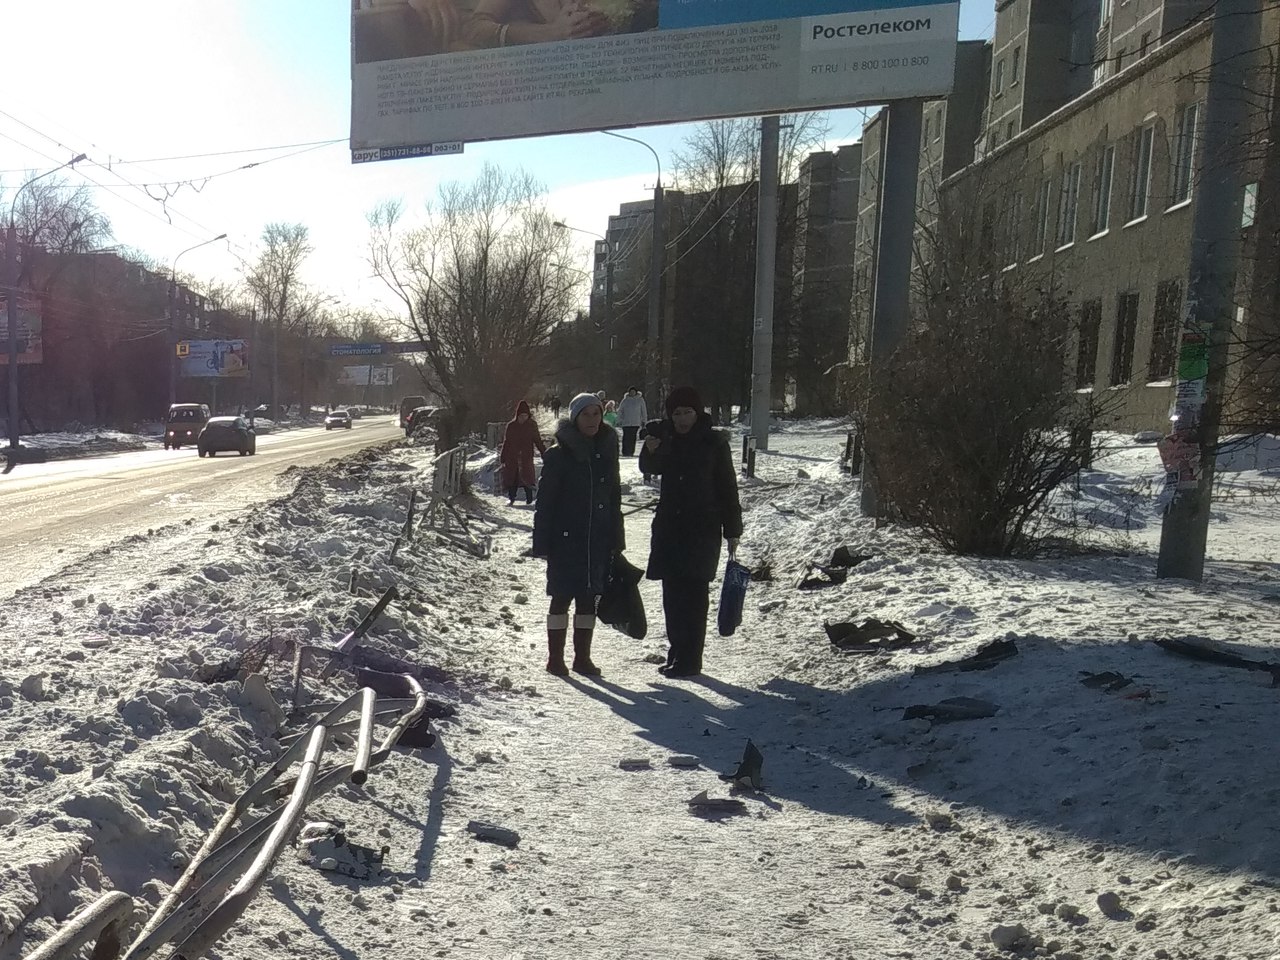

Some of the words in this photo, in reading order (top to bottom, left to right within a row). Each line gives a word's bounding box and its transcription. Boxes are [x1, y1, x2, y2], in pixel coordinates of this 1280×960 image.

[812, 18, 931, 40] Ростелеком
[852, 62, 859, 71] 8
[861, 60, 879, 70] 800
[882, 58, 900, 69] 100
[902, 57, 908, 67] 0
[911, 56, 929, 66] 800
